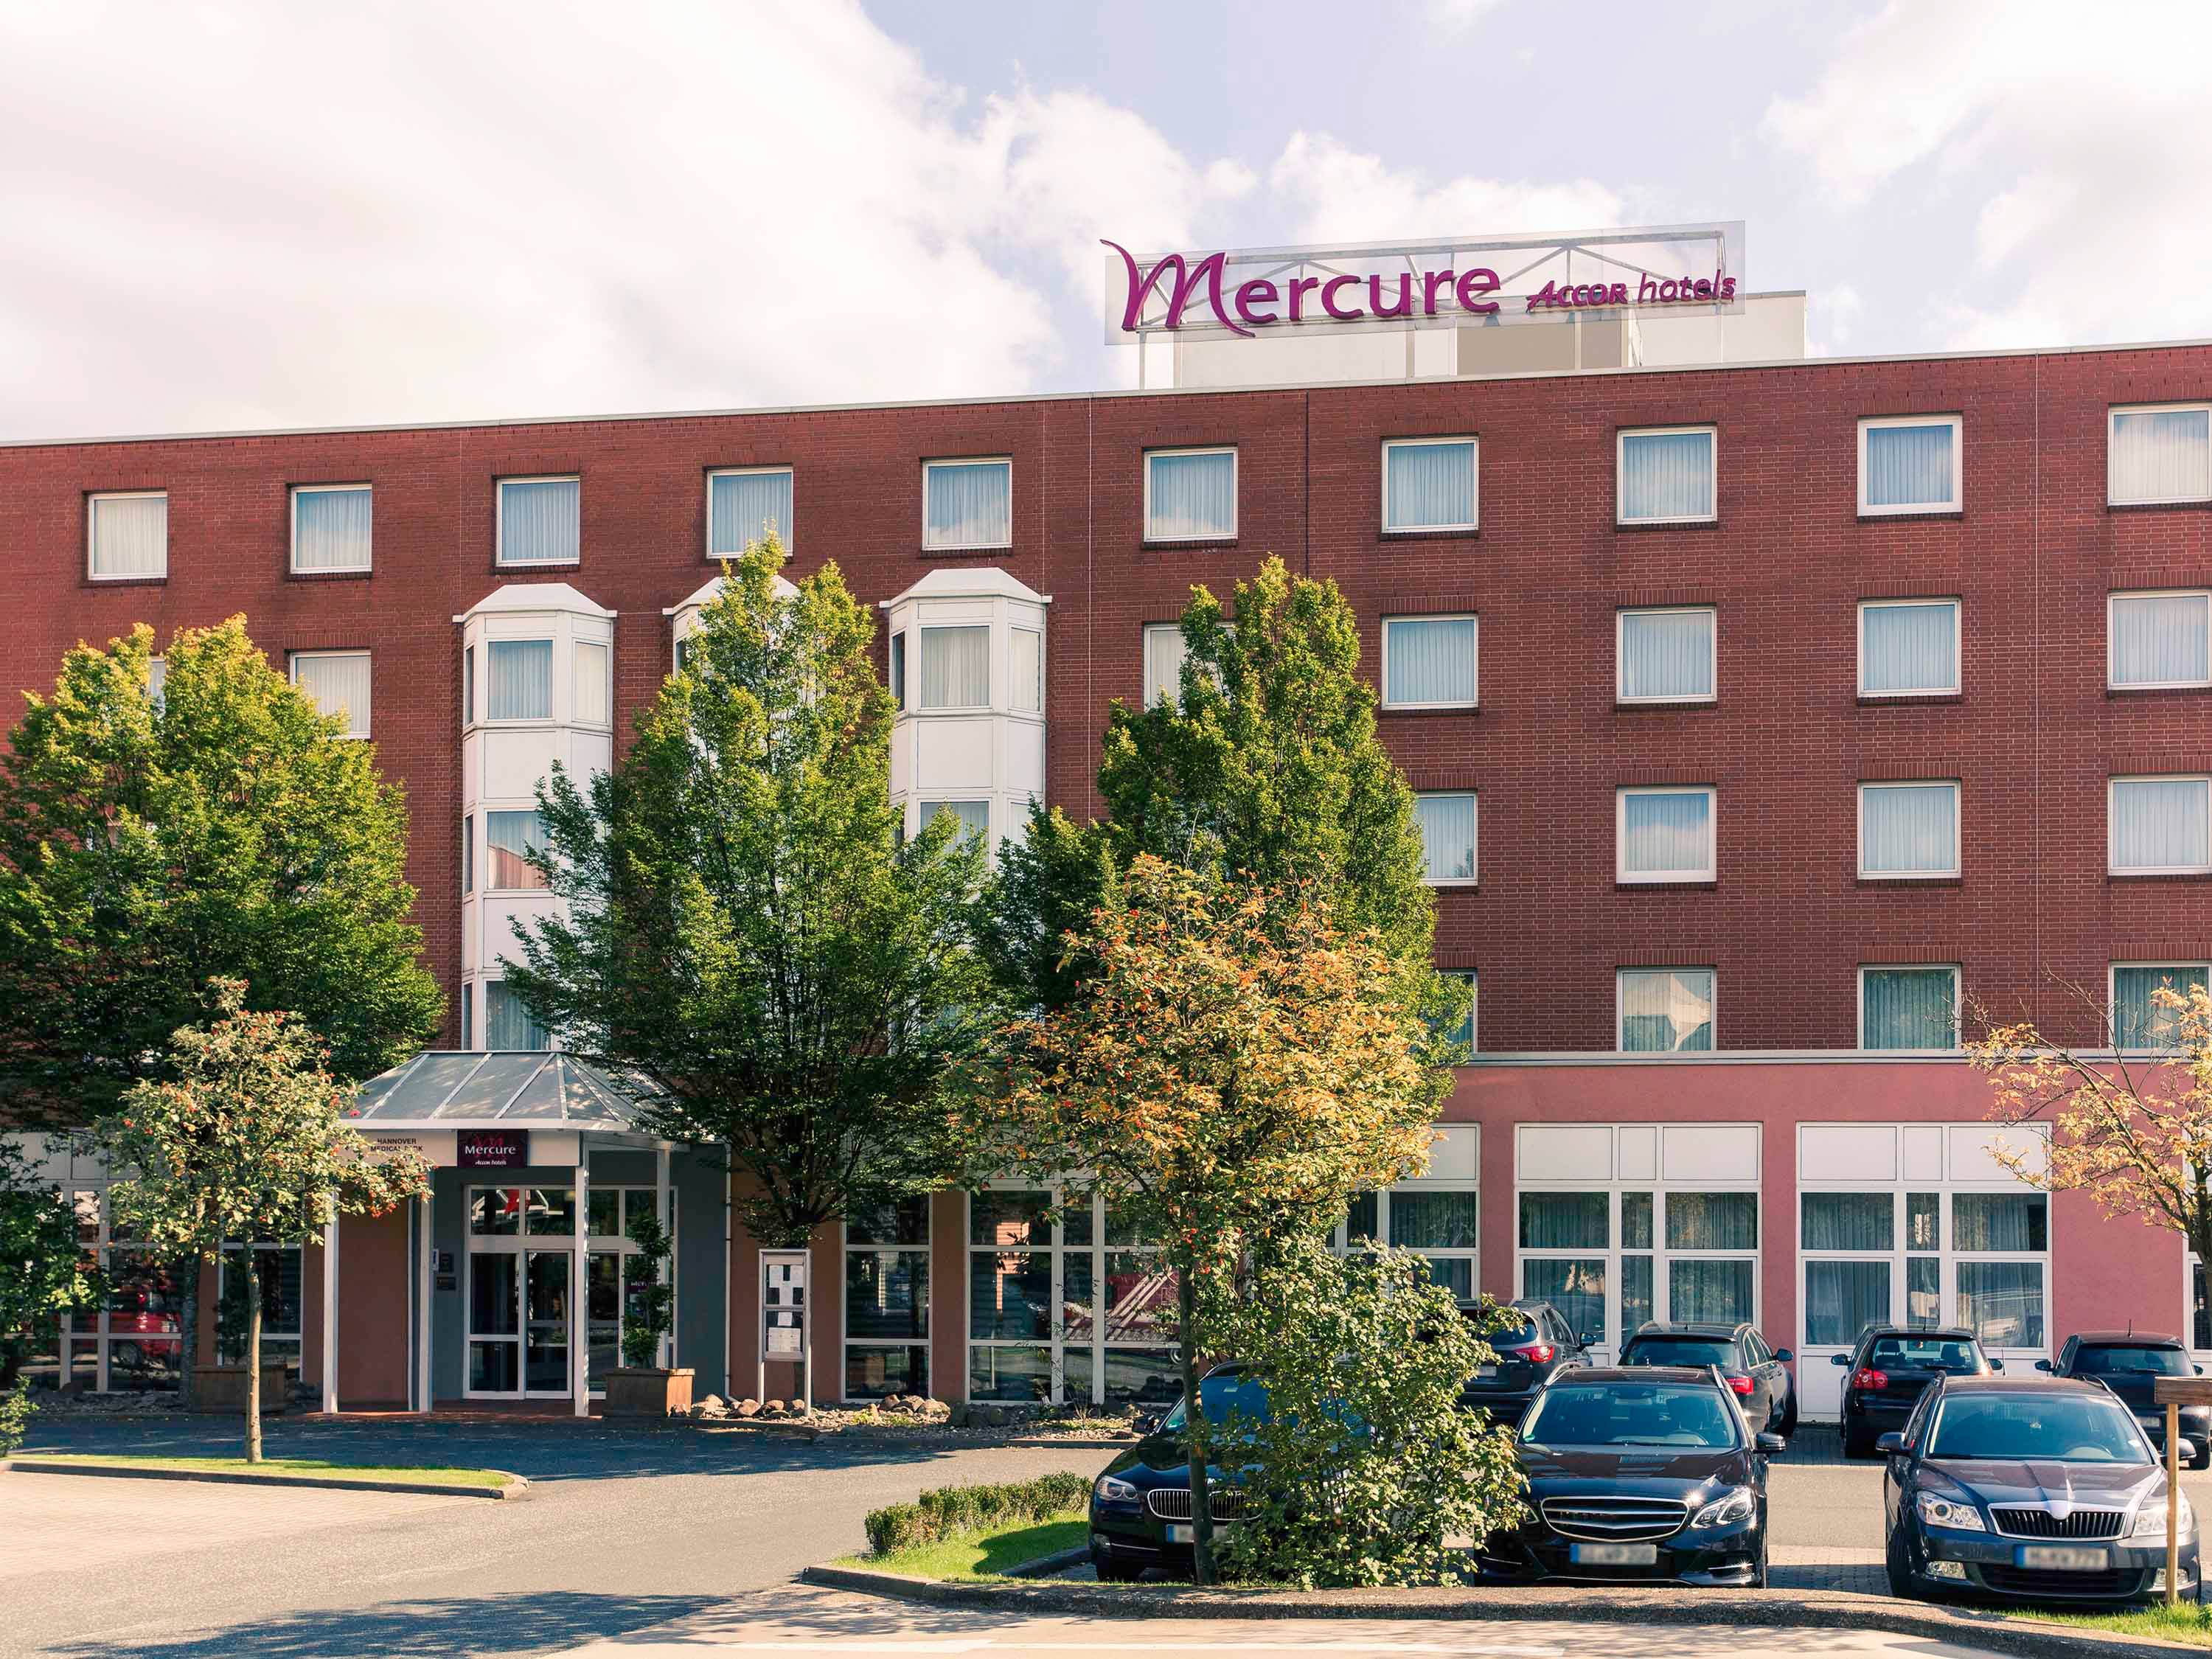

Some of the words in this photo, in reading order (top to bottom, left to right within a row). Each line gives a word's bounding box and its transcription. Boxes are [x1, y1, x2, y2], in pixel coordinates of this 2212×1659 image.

[1099, 239, 1500, 337] Mercure
[1638, 269, 1736, 305] hotels
[465, 1145, 516, 1155] Mercure
